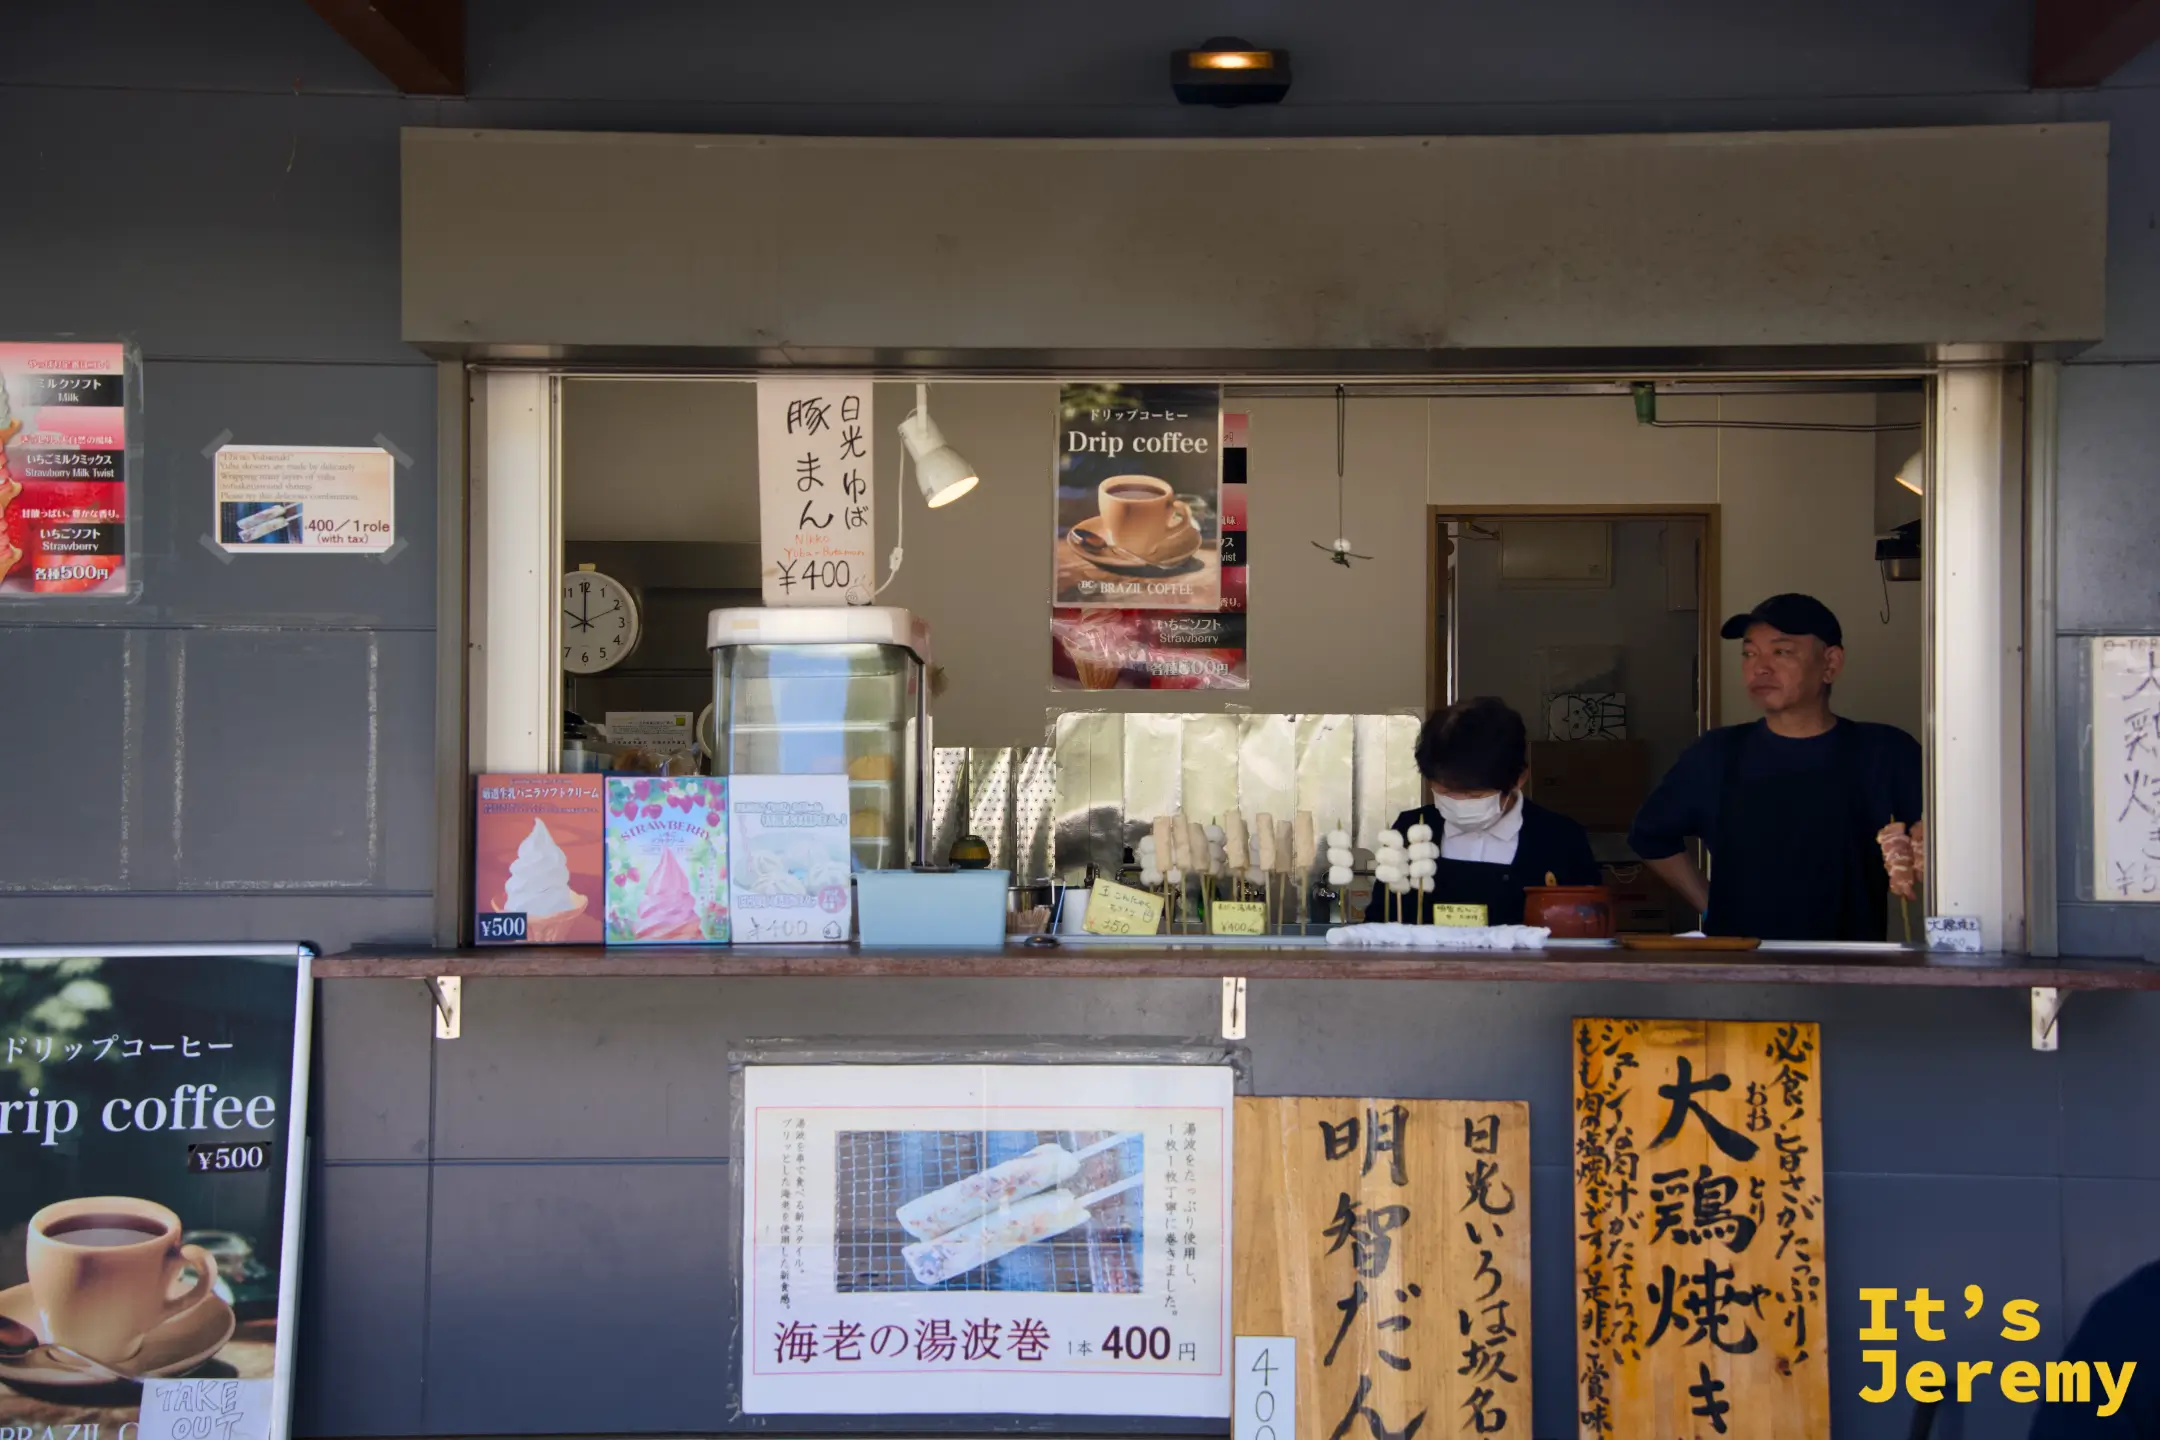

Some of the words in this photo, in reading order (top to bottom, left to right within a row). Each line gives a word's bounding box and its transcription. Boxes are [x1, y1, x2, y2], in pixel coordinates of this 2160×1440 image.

[39, 379, 102, 390] ミルクソフト
[58, 392, 79, 402] Milk
[1089, 408, 1189, 422] ドリップコーヒー
[1067, 431, 1123, 457] Drip
[1132, 431, 1209, 453] coffee
[26, 453, 113, 465] いちごミルクミックス
[787, 397, 834, 530] 豚まん
[25, 468, 71, 480] Strawberry
[72, 467, 90, 478] Milk
[93, 467, 115, 478] Twist
[40, 528, 101, 540] いちごソフト
[317, 534, 344, 544] (with
[347, 534, 369, 544] tax)
[42, 541, 99, 553] Strawberry
[777, 560, 850, 595] ¥400
[1100, 582, 1142, 594] BRAZIL
[1147, 583, 1195, 595] COFFEE
[618, 617, 626, 628] 3
[1157, 618, 1221, 631] いちごソフト
[613, 635, 621, 645] 4
[1160, 633, 1219, 645] Strawberry
[581, 652, 589, 663] 6
[599, 648, 607, 658] 5
[621, 820, 710, 840] STRAWBERRY
[480, 916, 525, 937] ¥500
[7, 1034, 234, 1063] ドリップコーヒー
[101, 1083, 277, 1132] coffee
[1746, 1081, 1772, 1133] おお
[197, 1146, 264, 1171] ¥500
[1750, 1176, 1766, 1227] とり
[1576, 1023, 1615, 1440] もも肉の塩焼きです!是非ご賞味
[1644, 1056, 1760, 1434] 大鶏焼き
[1457, 1114, 1519, 1440] 日光いろは坂名
[1750, 1284, 1772, 1321] や
[773, 1318, 1051, 1364] 海老の湯波巻
[156, 1380, 240, 1414] TAKE
[171, 1412, 244, 1440] OUT
